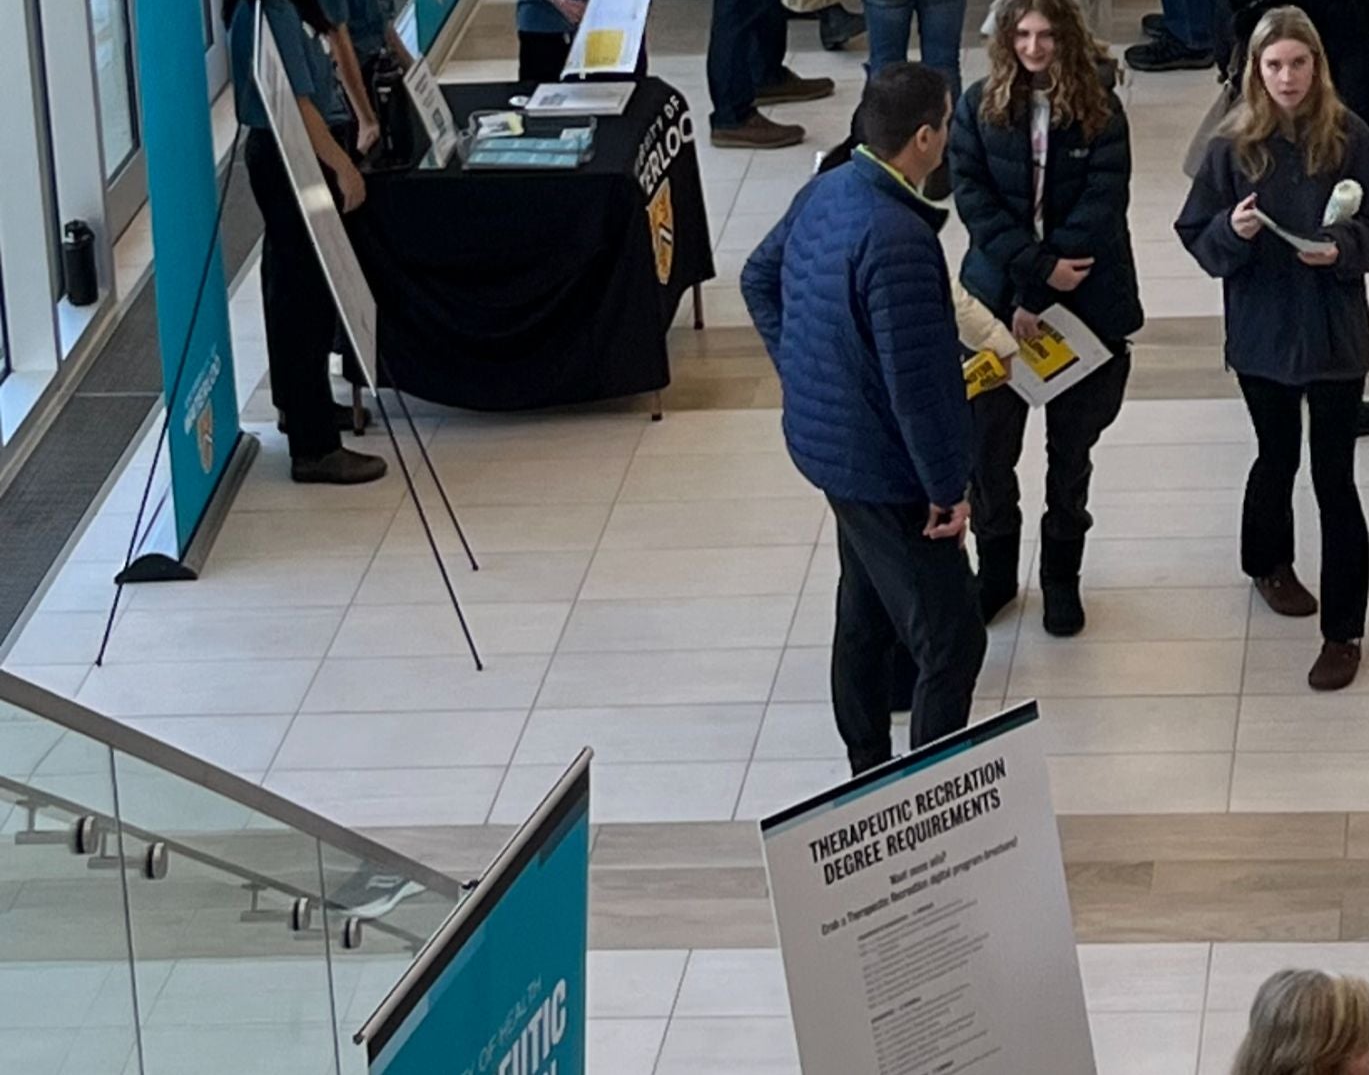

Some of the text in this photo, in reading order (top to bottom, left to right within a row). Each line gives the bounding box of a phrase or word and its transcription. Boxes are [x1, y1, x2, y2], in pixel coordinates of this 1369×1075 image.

[663, 94, 680, 119] OF
[809, 757, 1007, 864] THERAPEUTIC RECREATION
[823, 788, 1002, 885] DEGREE REQUIREMENTS
